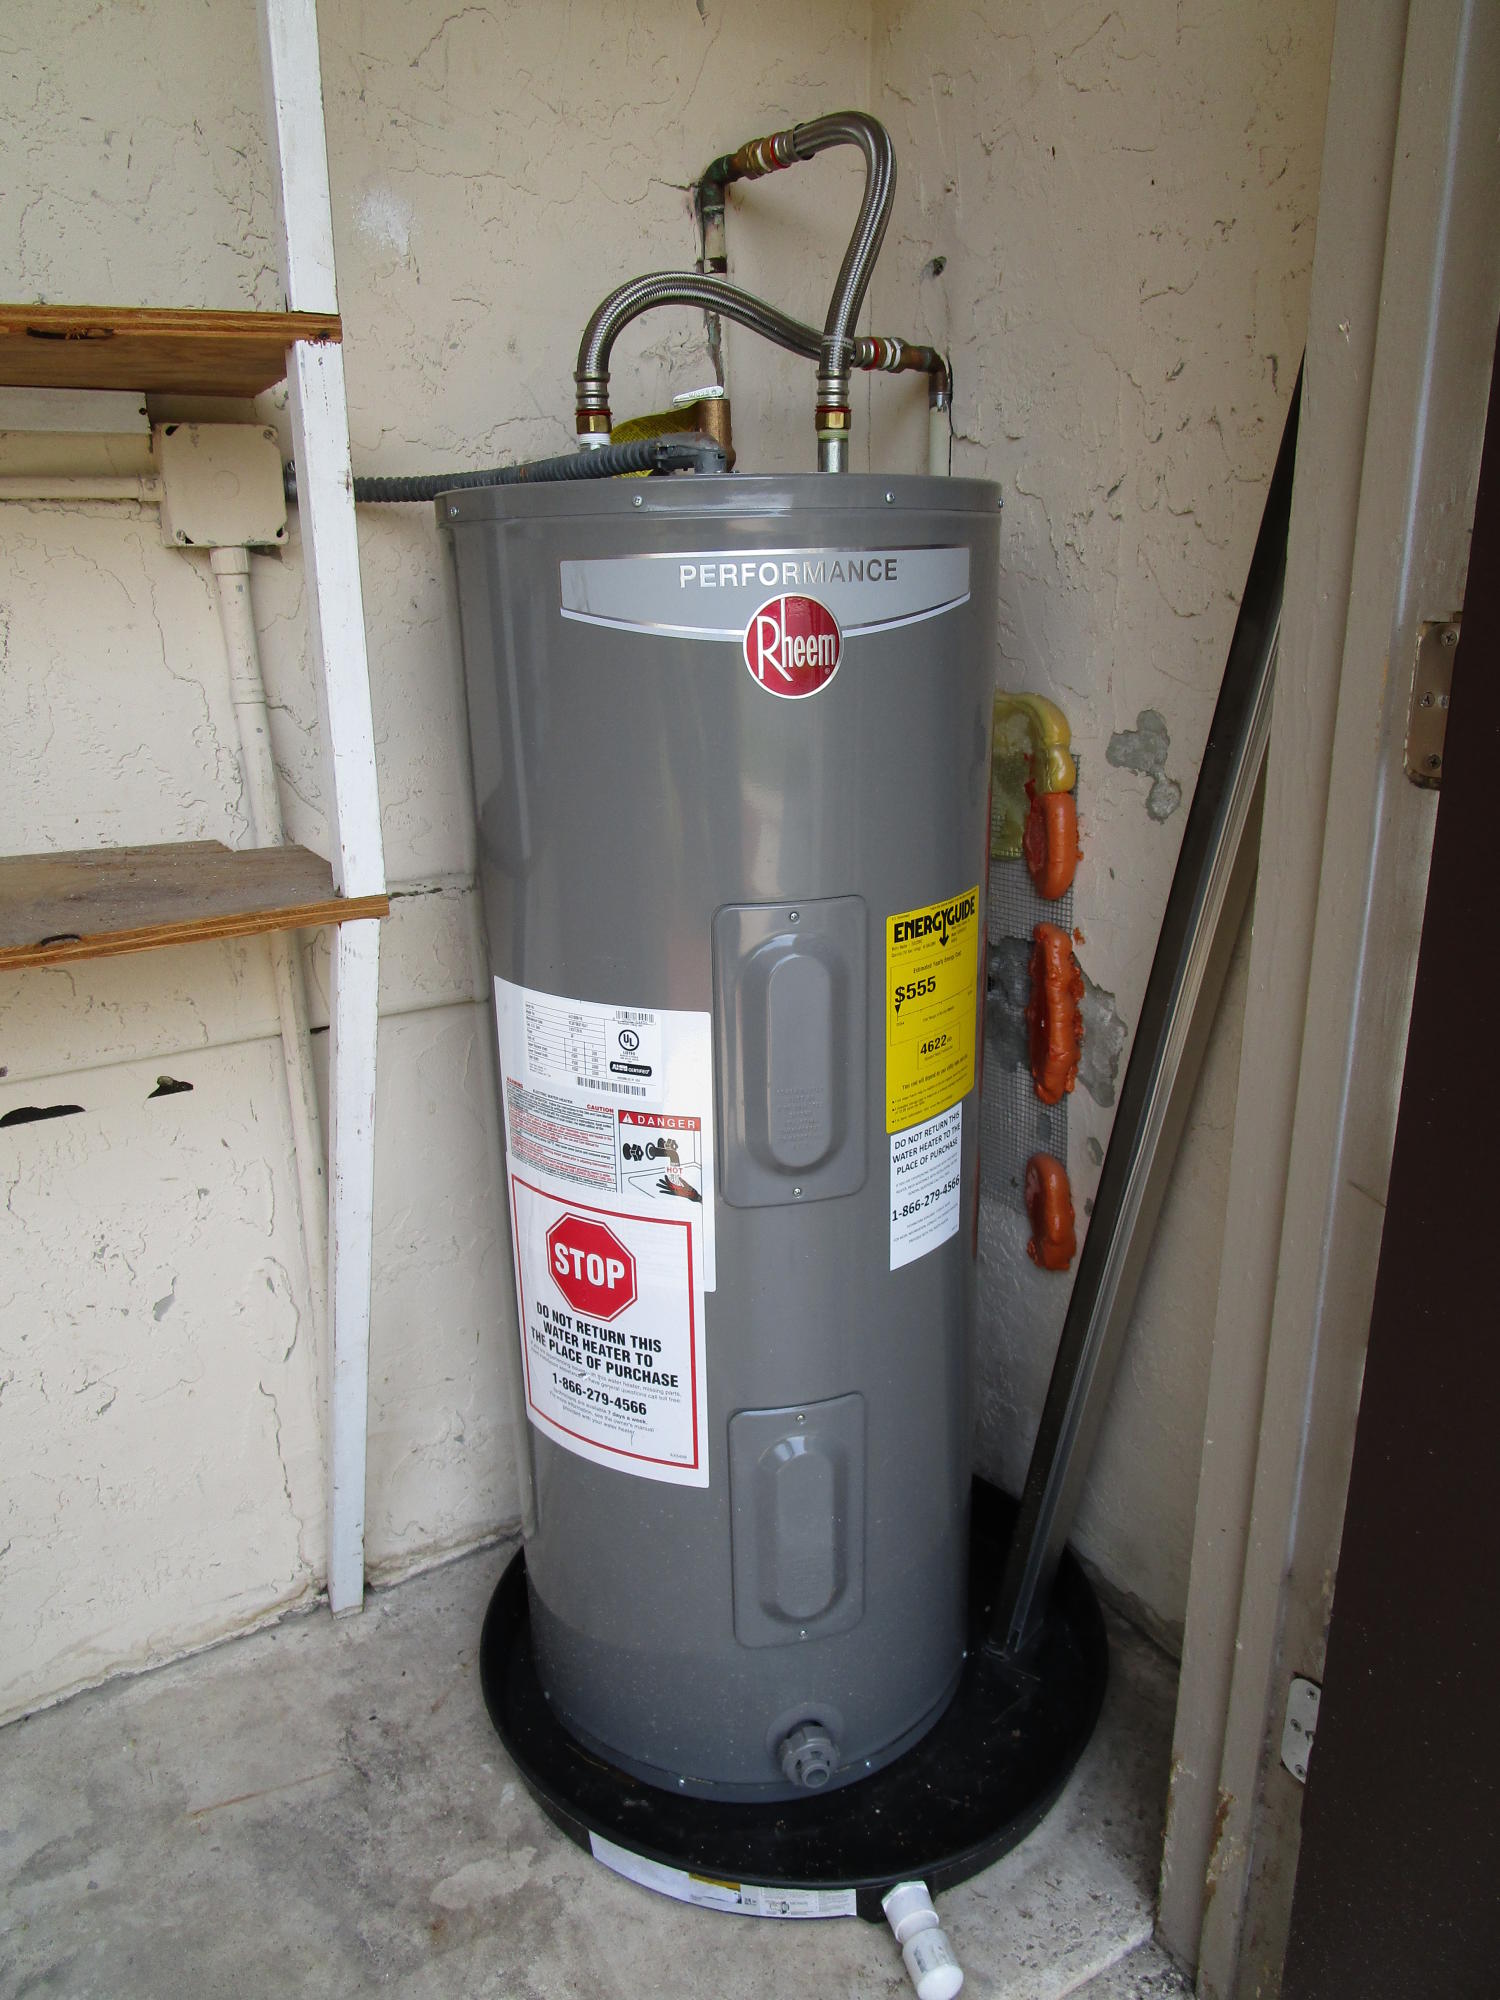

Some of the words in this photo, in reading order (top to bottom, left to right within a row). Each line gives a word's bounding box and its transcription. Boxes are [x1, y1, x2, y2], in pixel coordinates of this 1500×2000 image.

[679, 558, 898, 589] PERFORMANCE
[757, 597, 835, 682] Rheem
[894, 895, 975, 943] ENERGYGUIDE
[894, 975, 937, 1004] $555
[623, 1033, 634, 1047] UL
[920, 1034, 947, 1055] 4622
[586, 1104, 614, 1114] CAUTION
[638, 1115, 695, 1129] DANGER
[892, 1147, 918, 1163] WATER
[919, 1136, 943, 1153] HEATER
[943, 1131, 951, 1141] TO
[951, 1123, 961, 1135] THE
[894, 1137, 906, 1150] DO
[908, 1131, 923, 1145] NOT
[924, 1120, 948, 1138] RETURN
[949, 1111, 960, 1125] THIS
[896, 1159, 918, 1175] PLACE
[919, 1153, 929, 1165] OF
[930, 1136, 958, 1160] PURCHASE
[892, 1175, 960, 1222] 1-866-279-4566
[554, 1242, 625, 1290] STOP
[536, 1301, 549, 1318] DO
[552, 1310, 572, 1328] NOT
[576, 1320, 625, 1345] RETURN
[630, 1335, 662, 1353] THIS
[543, 1320, 579, 1347] WATER
[582, 1340, 631, 1364] HEATER
[636, 1352, 653, 1367] TO
[531, 1326, 546, 1347] THE
[549, 1340, 582, 1365] PLACE
[586, 1355, 602, 1372] OF
[606, 1361, 679, 1388] PURCHASE
[552, 1373, 647, 1415] 1-866-279-4566
